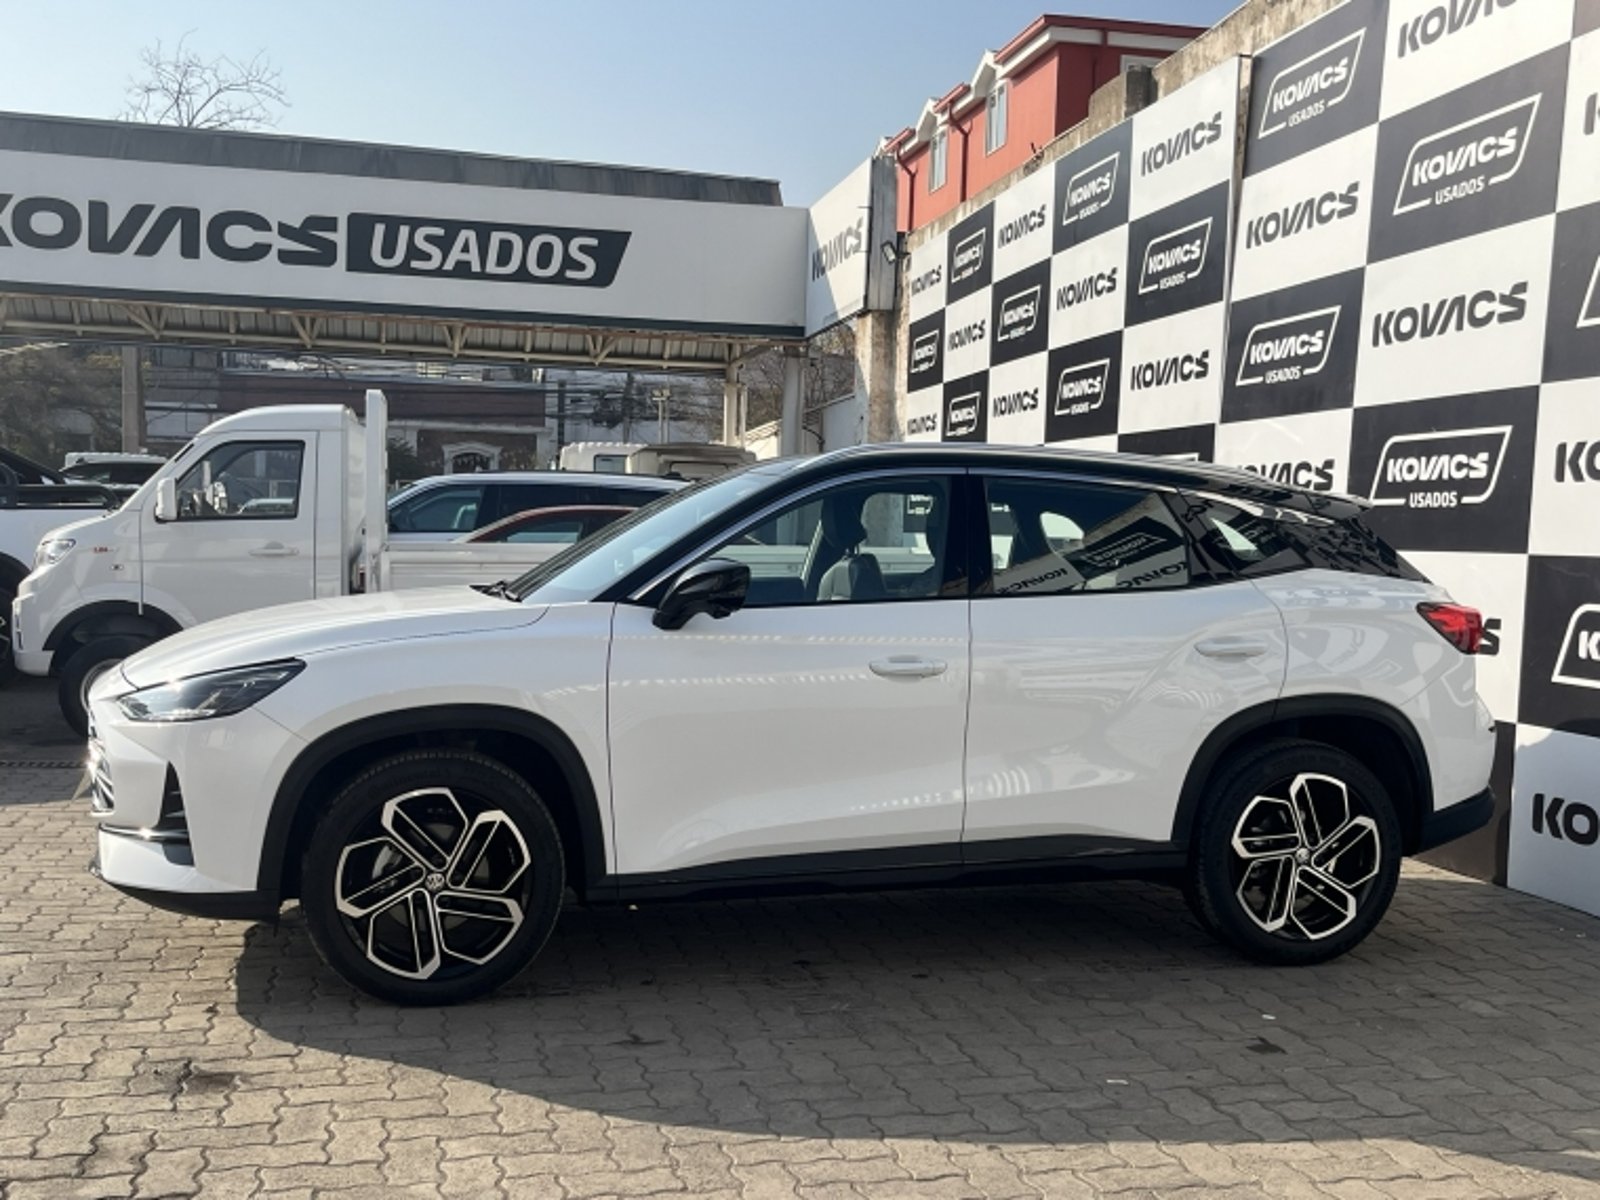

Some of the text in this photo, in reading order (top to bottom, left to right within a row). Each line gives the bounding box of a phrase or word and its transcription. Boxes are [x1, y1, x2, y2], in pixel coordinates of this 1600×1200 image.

[1272, 57, 1349, 114] KOVACS
[1288, 100, 1326, 127] USADOS
[1141, 111, 1222, 176] KOVACS
[1412, 127, 1518, 186] KOVACS
[1070, 172, 1111, 206] KOVACS
[1434, 176, 1485, 206] USADOS
[999, 204, 1047, 249] KOVACS
[1246, 181, 1360, 249] KOVACS
[0, 193, 599, 281] OVACS USADOS
[1148, 239, 1202, 275] KOVACS
[1056, 267, 1118, 311] KOVACS
[1372, 281, 1529, 348] KOVACS
[1250, 330, 1325, 365] KOVACS
[1061, 376, 1102, 400] KOVACS
[1130, 349, 1210, 391] KOVACS
[1264, 365, 1302, 384] USADOS
[993, 387, 1039, 418] KOVACS
[1386, 451, 1489, 484] KOVACS
[1409, 491, 1458, 509] USADOS
